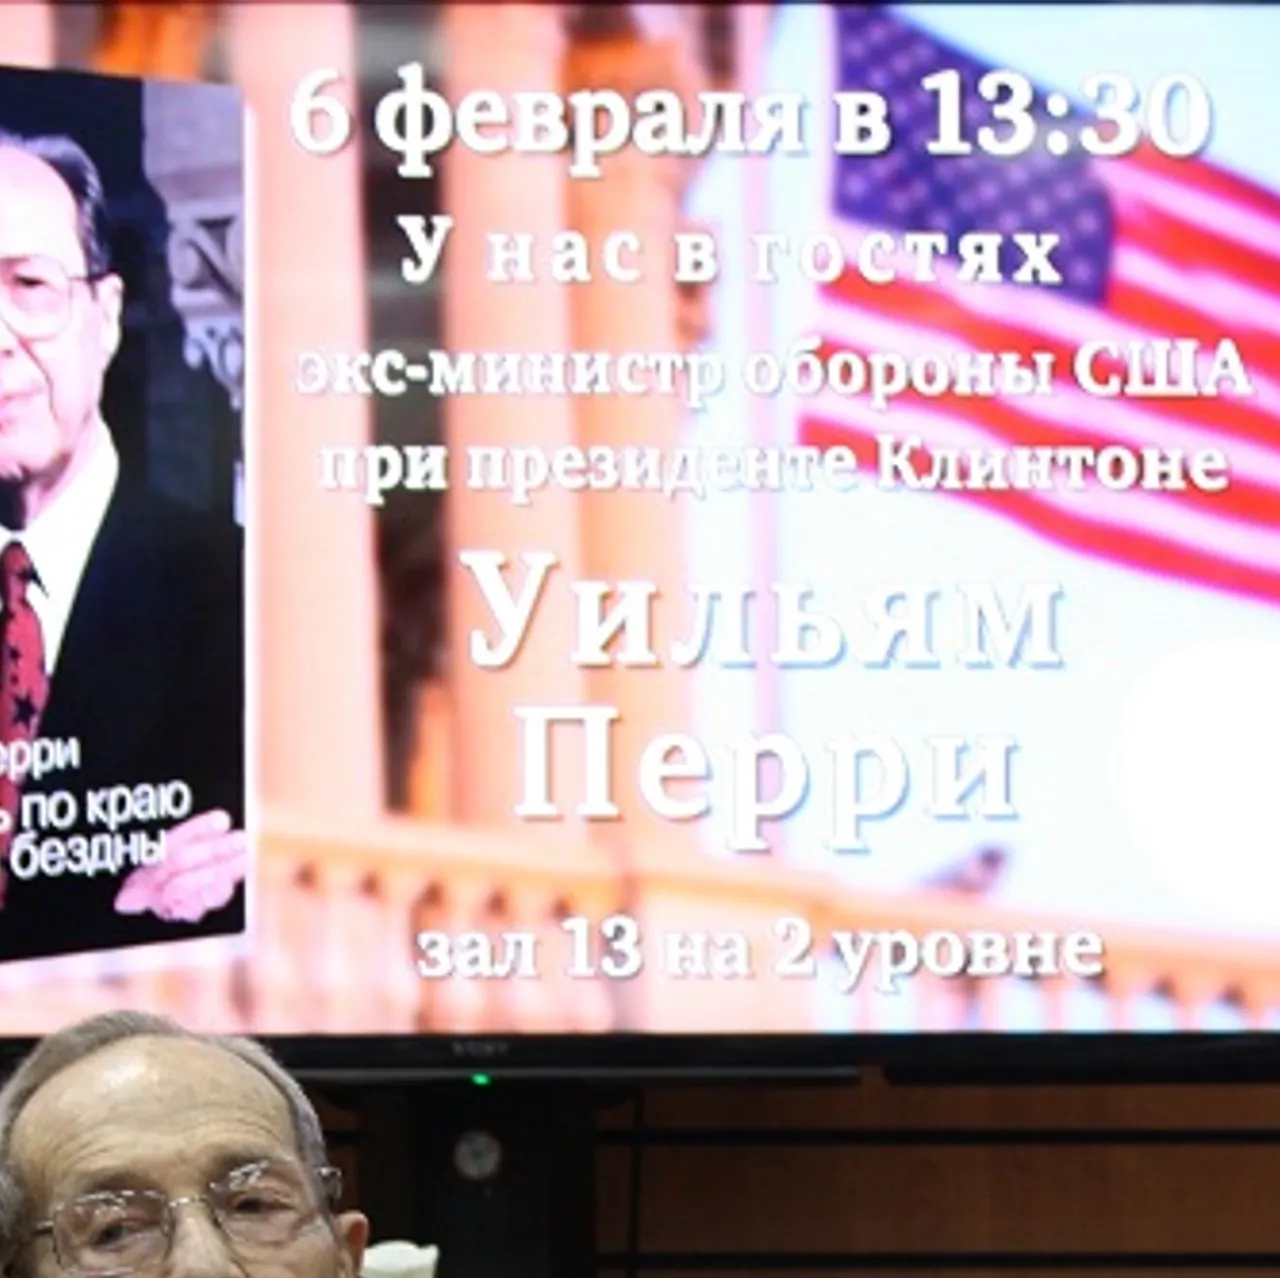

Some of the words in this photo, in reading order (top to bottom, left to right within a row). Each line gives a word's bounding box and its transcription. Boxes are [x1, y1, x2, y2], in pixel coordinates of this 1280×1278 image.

[290, 68, 351, 154] 6
[376, 62, 807, 178] февраля
[836, 92, 891, 156] в
[921, 68, 1211, 158] 13:30
[397, 214, 454, 284] У
[488, 230, 642, 284] нас
[675, 233, 718, 284] в
[754, 232, 1064, 285] гостях
[296, 347, 719, 408] экс-министр
[745, 338, 1054, 409] обороны
[1074, 338, 1255, 397] США
[320, 445, 449, 504] при
[468, 443, 857, 506] президенте
[877, 435, 1230, 493] Клинтоне
[456, 548, 1068, 674] Уильям
[21, 791, 77, 831] по
[86, 780, 192, 826] краю
[513, 702, 1022, 854] Перри
[10, 827, 166, 879] бездны
[417, 928, 539, 980] зал
[562, 917, 642, 980] 13
[665, 928, 750, 977] на
[773, 917, 816, 977] 2
[820, 926, 1106, 994] уровне
